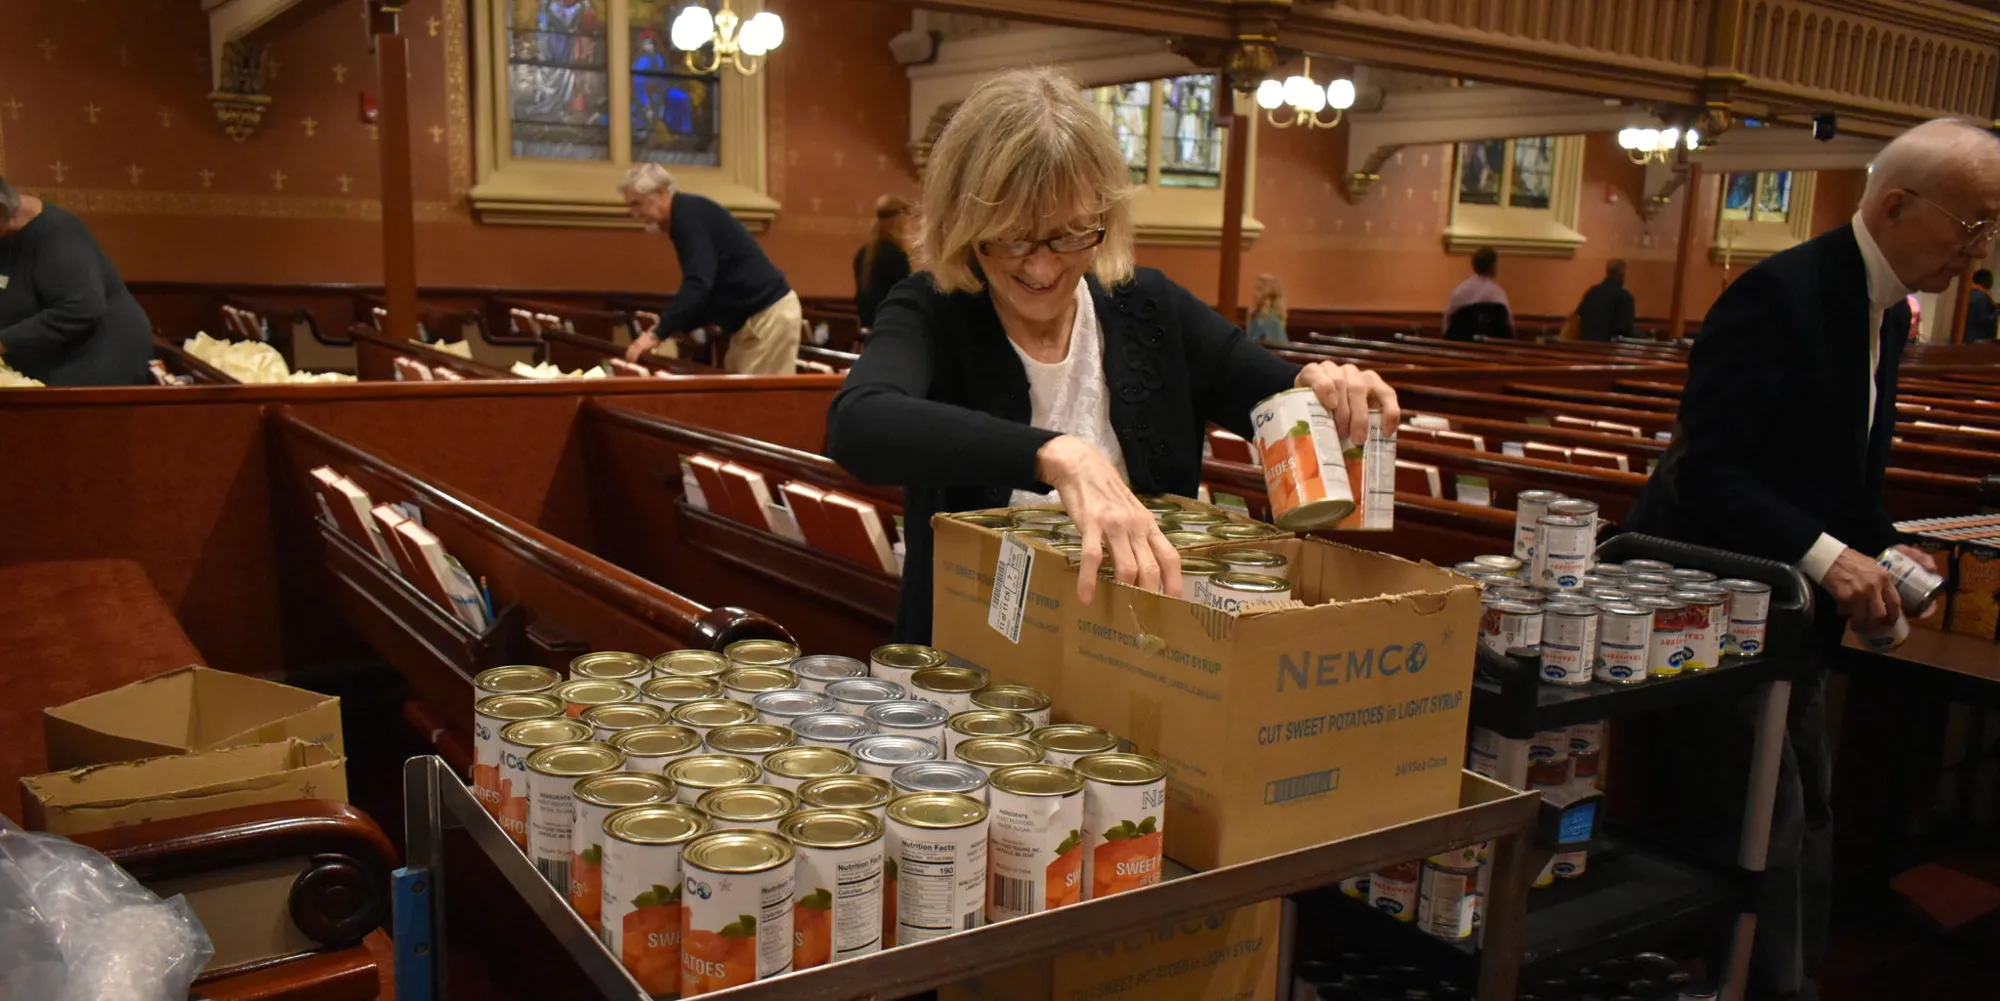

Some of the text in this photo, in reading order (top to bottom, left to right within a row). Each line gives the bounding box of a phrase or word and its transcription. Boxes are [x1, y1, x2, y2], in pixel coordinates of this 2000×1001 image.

[1078, 618, 1091, 632] CUT
[1092, 623, 1118, 640] SWEET
[1167, 649, 1191, 666] LIGHT
[1192, 655, 1222, 675] SYRUP
[1276, 641, 1428, 692] NEMCO
[1258, 690, 1464, 745] CUT SWEET POTATOES in LIGHT SYRUP
[902, 840, 955, 852] Nutrition Facts
[837, 861, 869, 872] Nutrition
[940, 866, 953, 875] 190
[1116, 857, 1157, 876] SWEET
[684, 952, 726, 978] ATOES
